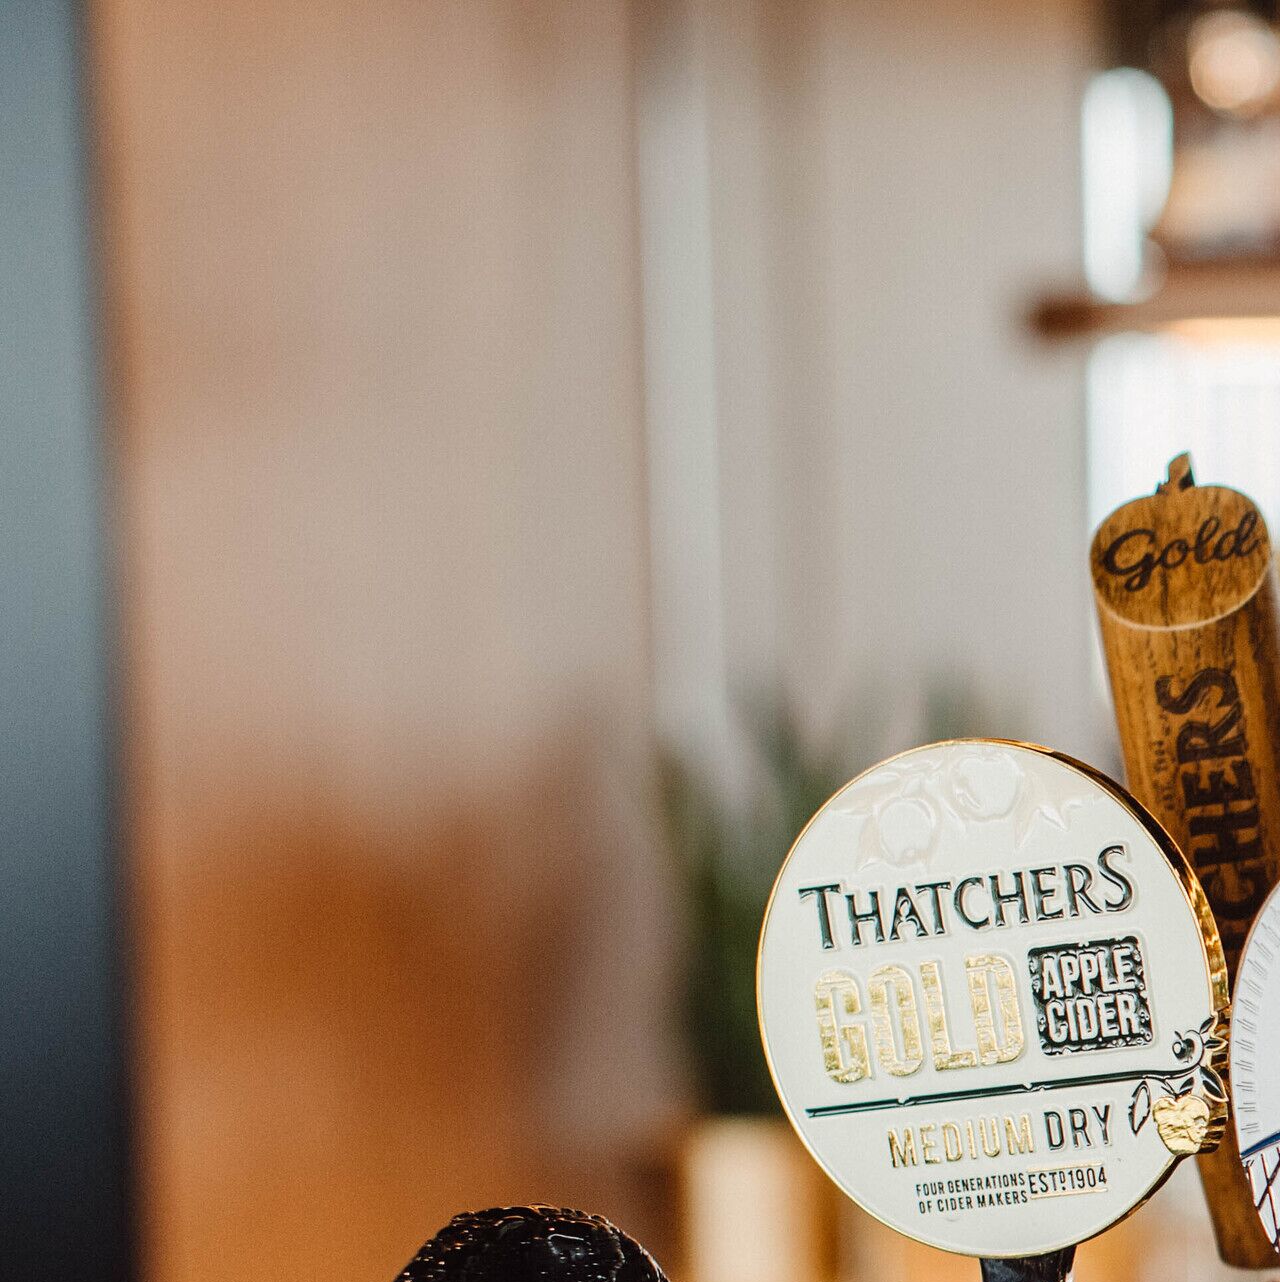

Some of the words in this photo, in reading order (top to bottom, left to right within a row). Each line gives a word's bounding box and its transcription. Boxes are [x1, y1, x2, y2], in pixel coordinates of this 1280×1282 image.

[1102, 511, 1265, 593] Gold
[798, 844, 1134, 949] THATCHERS
[1041, 945, 1137, 1001] APPLE
[814, 953, 1025, 1084] GOLD
[1043, 993, 1143, 1044] CIDER
[887, 1112, 1035, 1168] MEDIUM
[1044, 1104, 1111, 1151] DRY
[916, 1181, 945, 1197] FOUR
[949, 1172, 1025, 1193] GENERATIONS
[918, 1200, 933, 1214] OF
[937, 1196, 974, 1212] CIDER
[977, 1191, 1028, 1208] MAKERS
